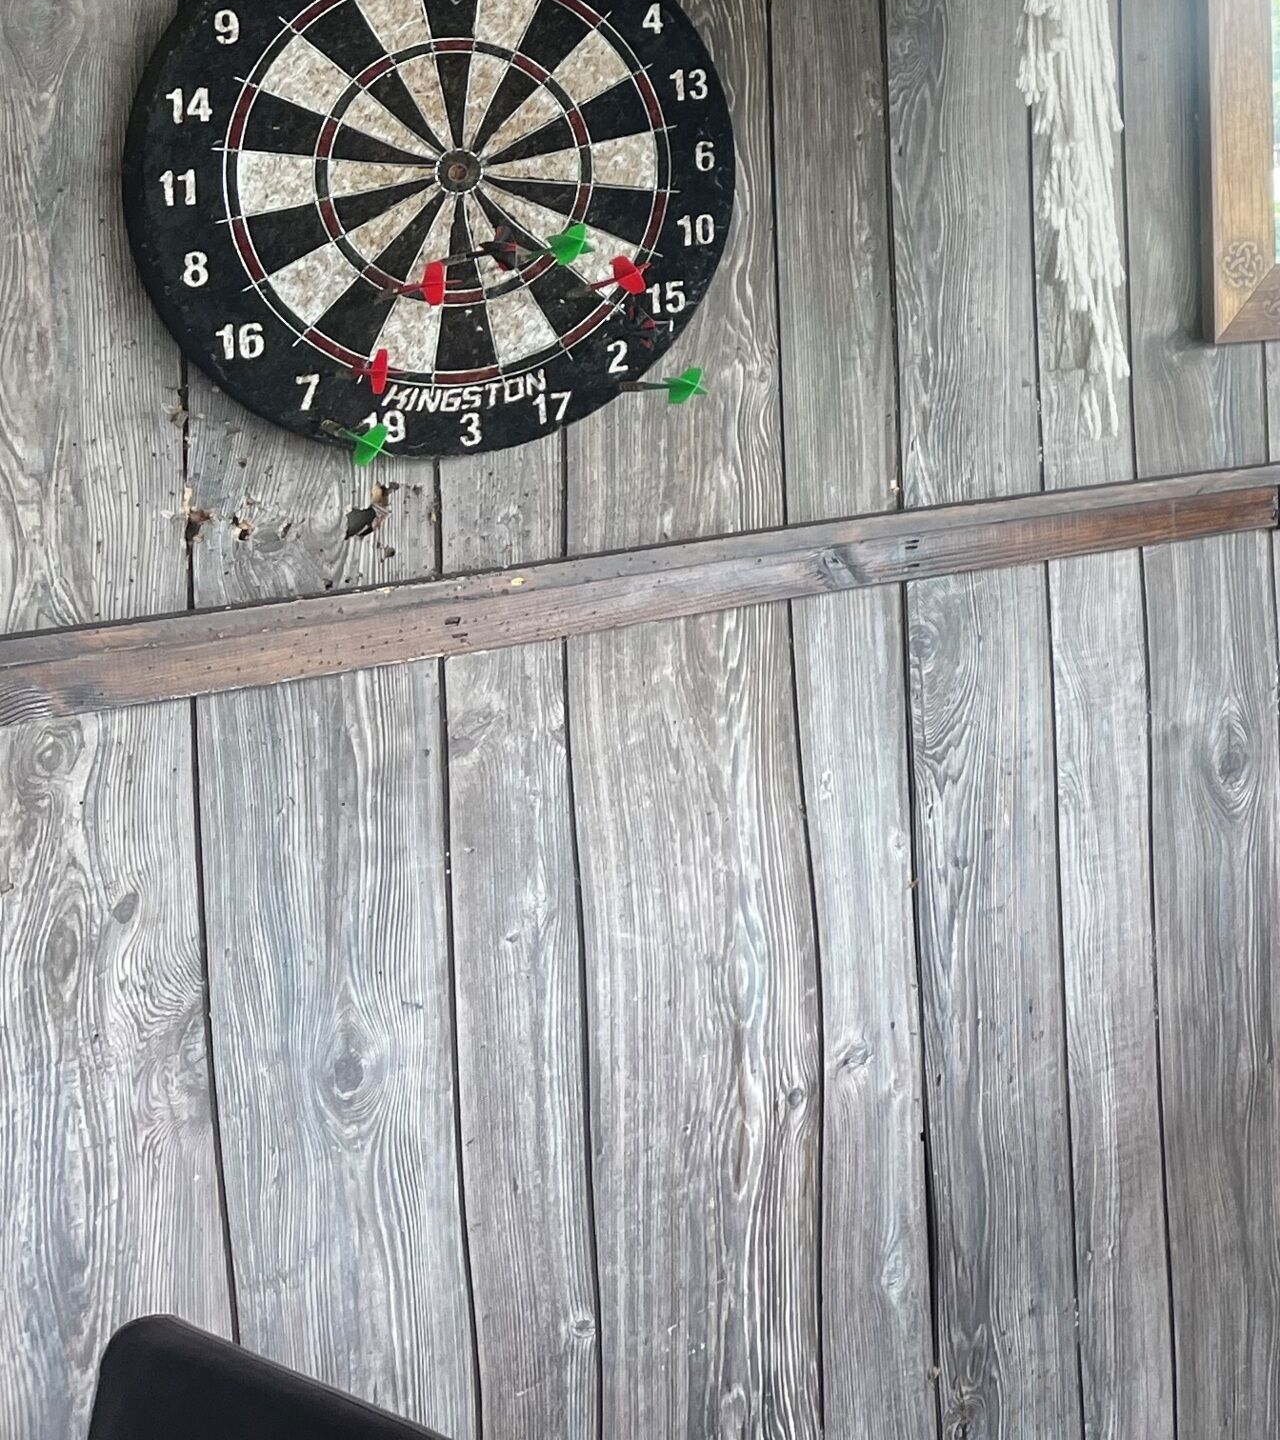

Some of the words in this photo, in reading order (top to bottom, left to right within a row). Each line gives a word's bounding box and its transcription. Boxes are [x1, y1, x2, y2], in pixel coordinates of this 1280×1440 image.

[214, 10, 239, 44] 9
[642, 3, 663, 34] 4
[670, 69, 708, 100] 13
[166, 88, 213, 123] 14
[695, 140, 715, 171] 6
[159, 171, 196, 205] 11
[677, 214, 715, 246] 10
[183, 252, 208, 287] 8
[646, 281, 686, 313] 15
[215, 323, 264, 358] 16
[606, 341, 629, 373] 2
[297, 374, 319, 410] 7
[381, 368, 546, 412] KINGSTON
[532, 391, 572, 425] 17
[459, 412, 482, 447] 3
